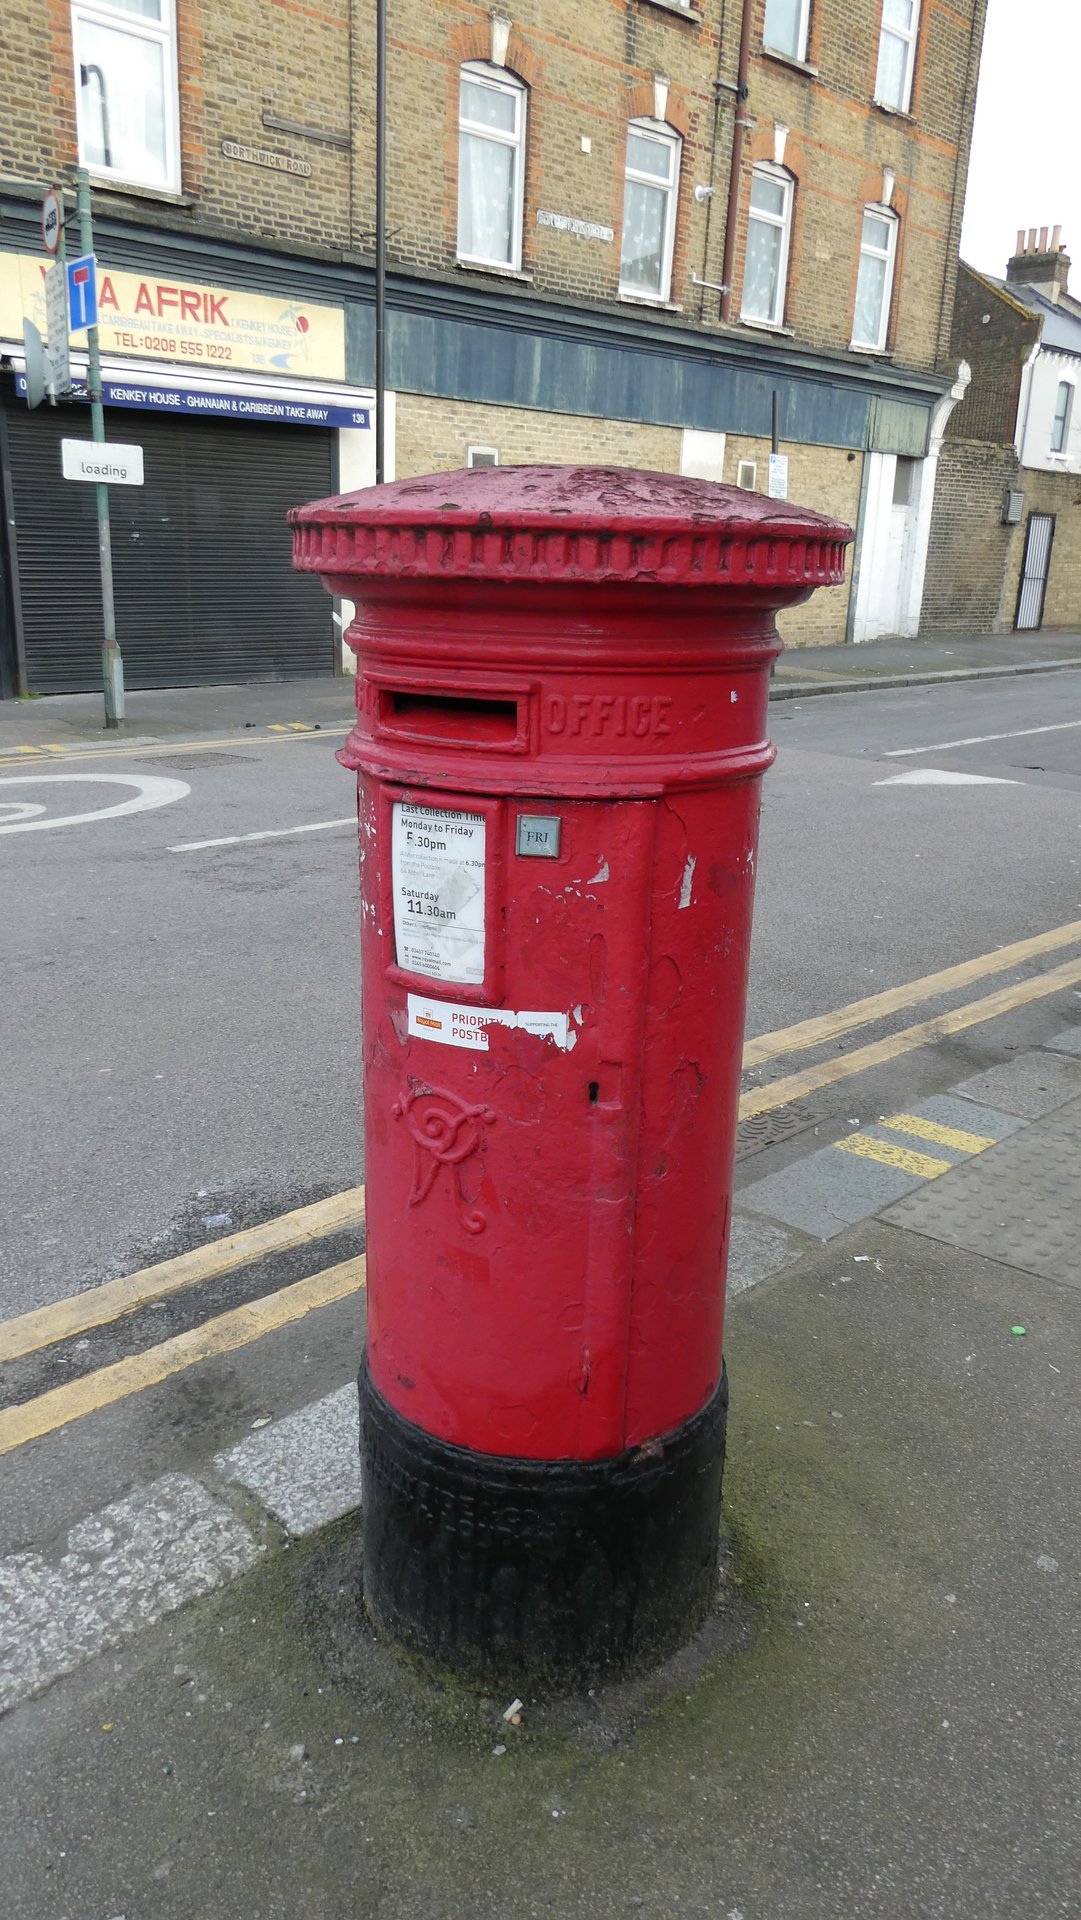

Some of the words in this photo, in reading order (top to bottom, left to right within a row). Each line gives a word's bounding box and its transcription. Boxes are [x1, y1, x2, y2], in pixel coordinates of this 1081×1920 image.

[226, 144, 281, 167] BORTHWICK
[286, 159, 310, 174] ROAD
[134, 282, 230, 327] AFRIK
[180, 340, 203, 357] 555
[206, 343, 232, 360] 1222
[110, 388, 147, 401] KENKEY
[148, 392, 181, 406] HOUSE
[187, 395, 231, 411] GHANAIAN
[231, 403, 238, 412] &
[239, 400, 284, 416] CARIBBEAN
[285, 405, 306, 419] TAKE
[306, 408, 329, 421] AWAY
[352, 413, 365, 424] 138
[81, 461, 127, 478] loading
[546, 694, 672, 737] OFFICE
[401, 818, 433, 832] Monday
[445, 824, 474, 838] Friday
[406, 831, 447, 851] 5.30pm
[401, 886, 440, 903] Saturday
[407, 899, 456, 920] 11.30am
